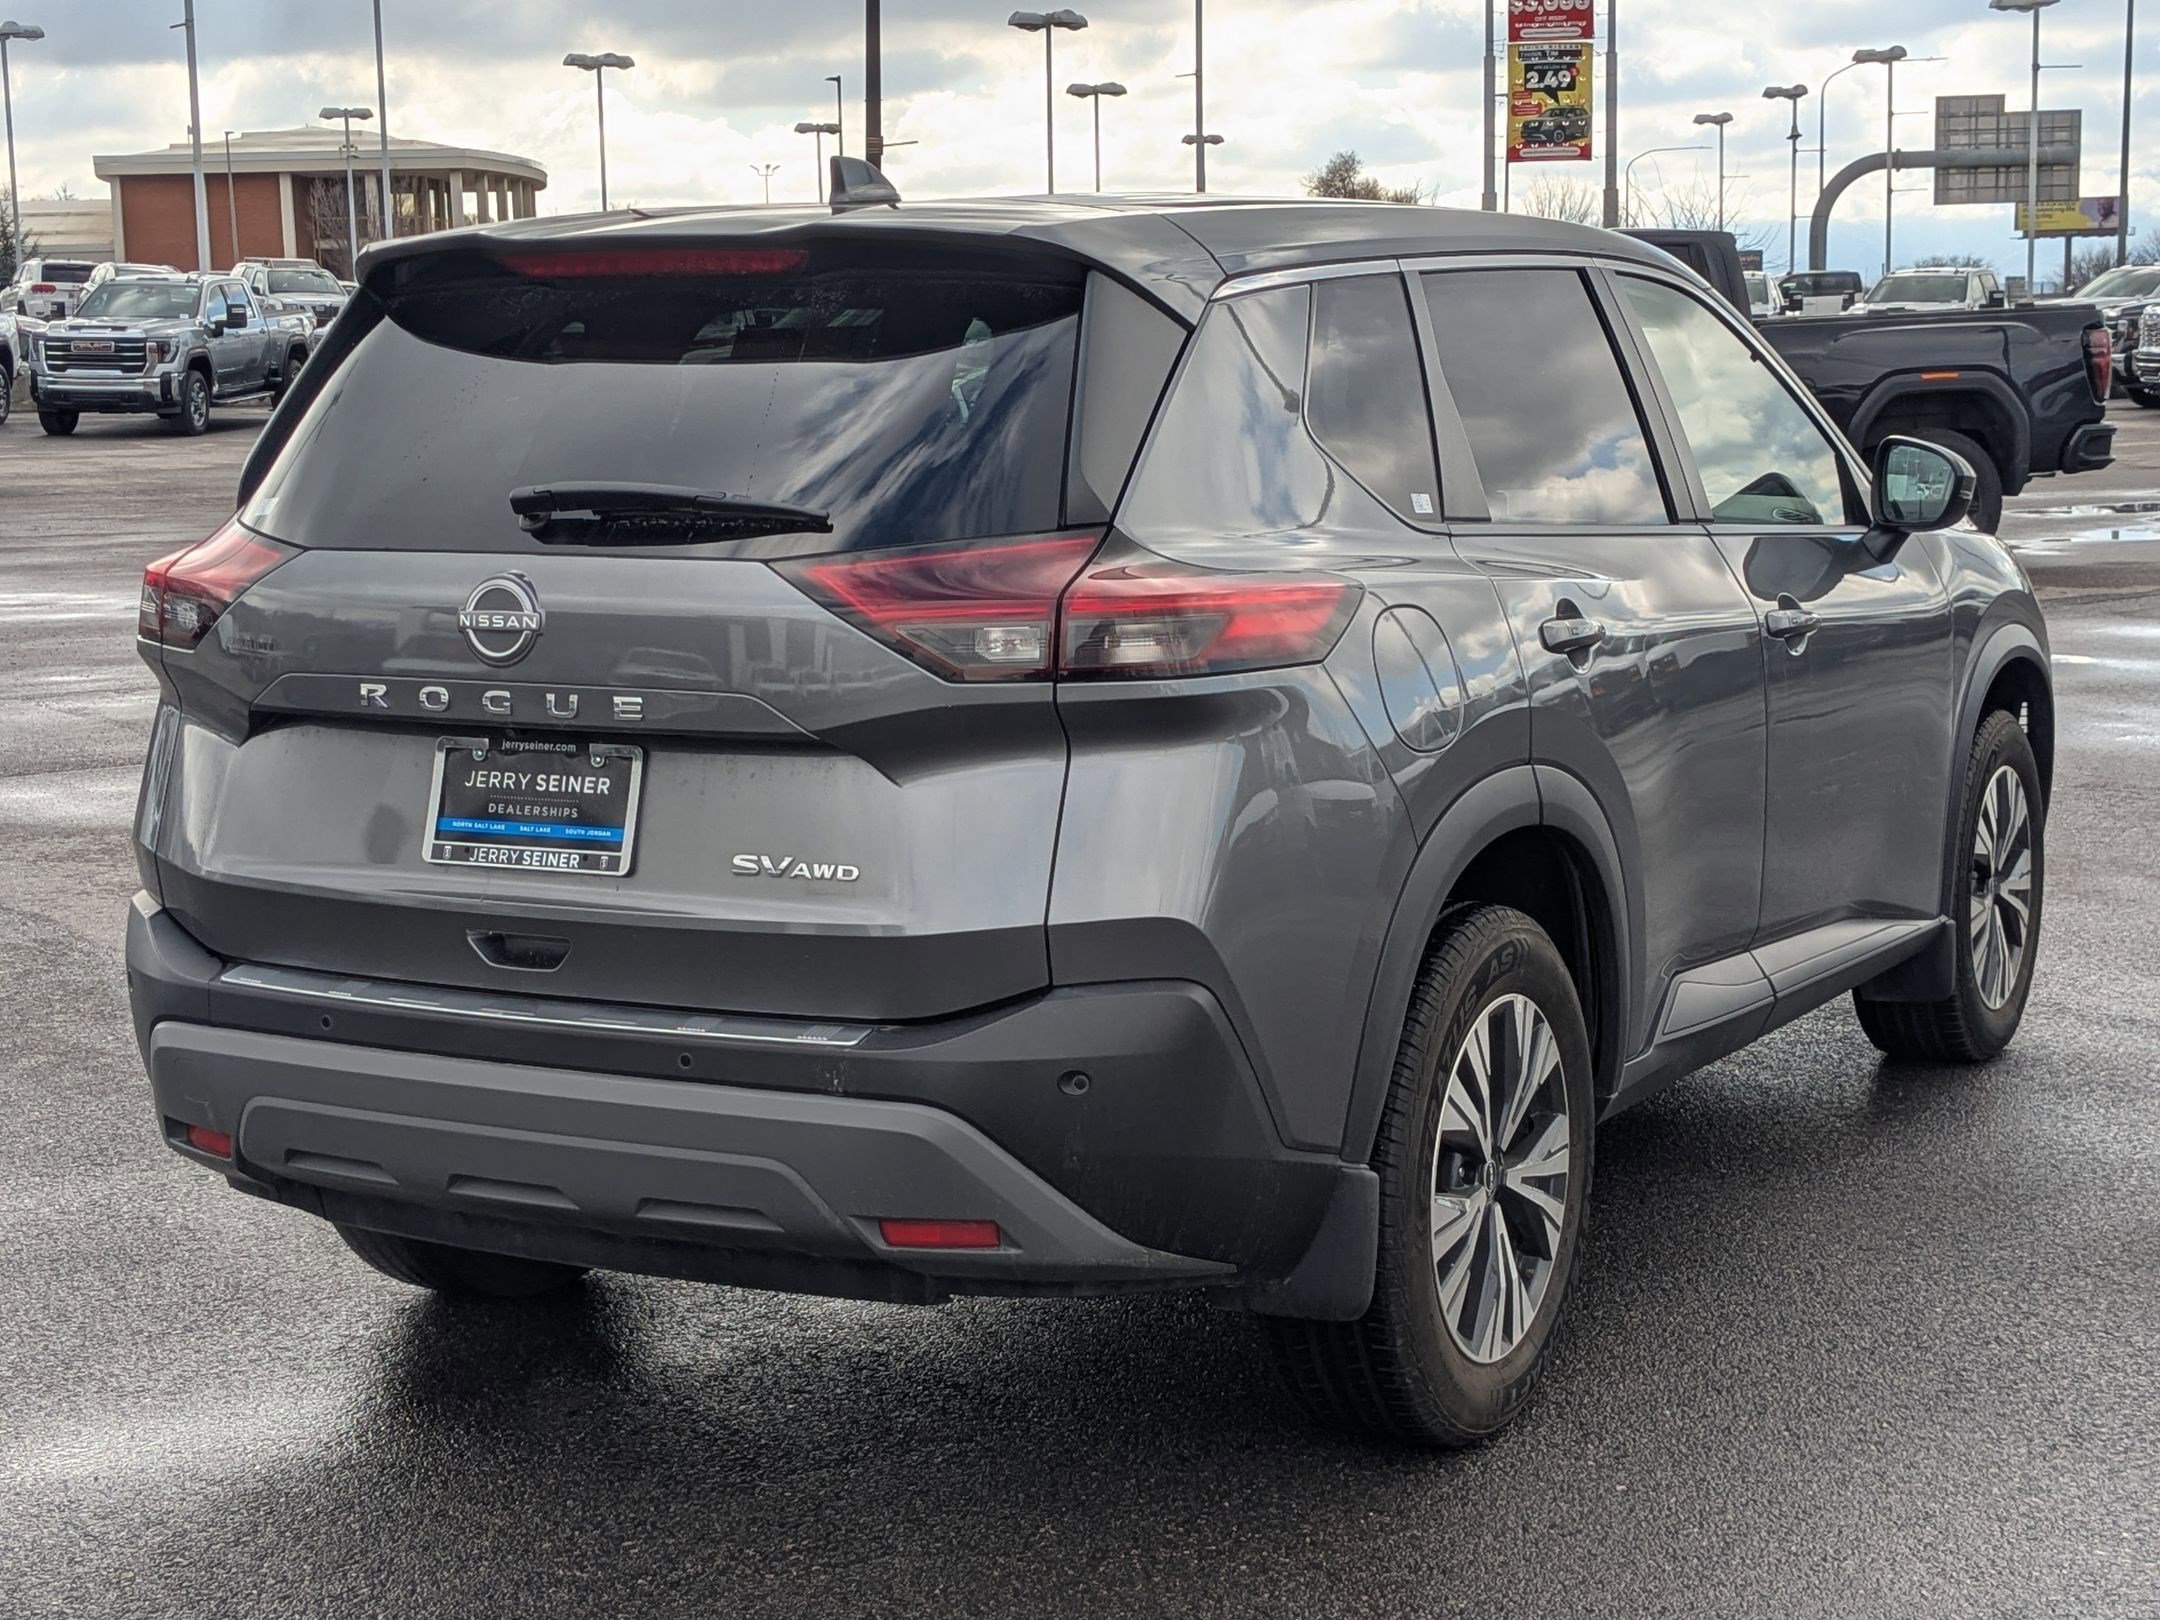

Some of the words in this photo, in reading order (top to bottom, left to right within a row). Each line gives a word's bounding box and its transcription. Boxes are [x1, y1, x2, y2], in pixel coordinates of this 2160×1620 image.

[1526, 70, 1572, 89] 2.49
[460, 613, 538, 628] NISSAN
[360, 683, 644, 721] ROGUE
[501, 738, 577, 753] jerryseiner.com
[464, 770, 533, 791] JERRY
[535, 774, 611, 795] SEINER
[488, 803, 579, 818] DEALERSHIPS
[469, 847, 519, 864] JERRY
[521, 850, 580, 868] SEINER
[790, 862, 860, 881] AWD
